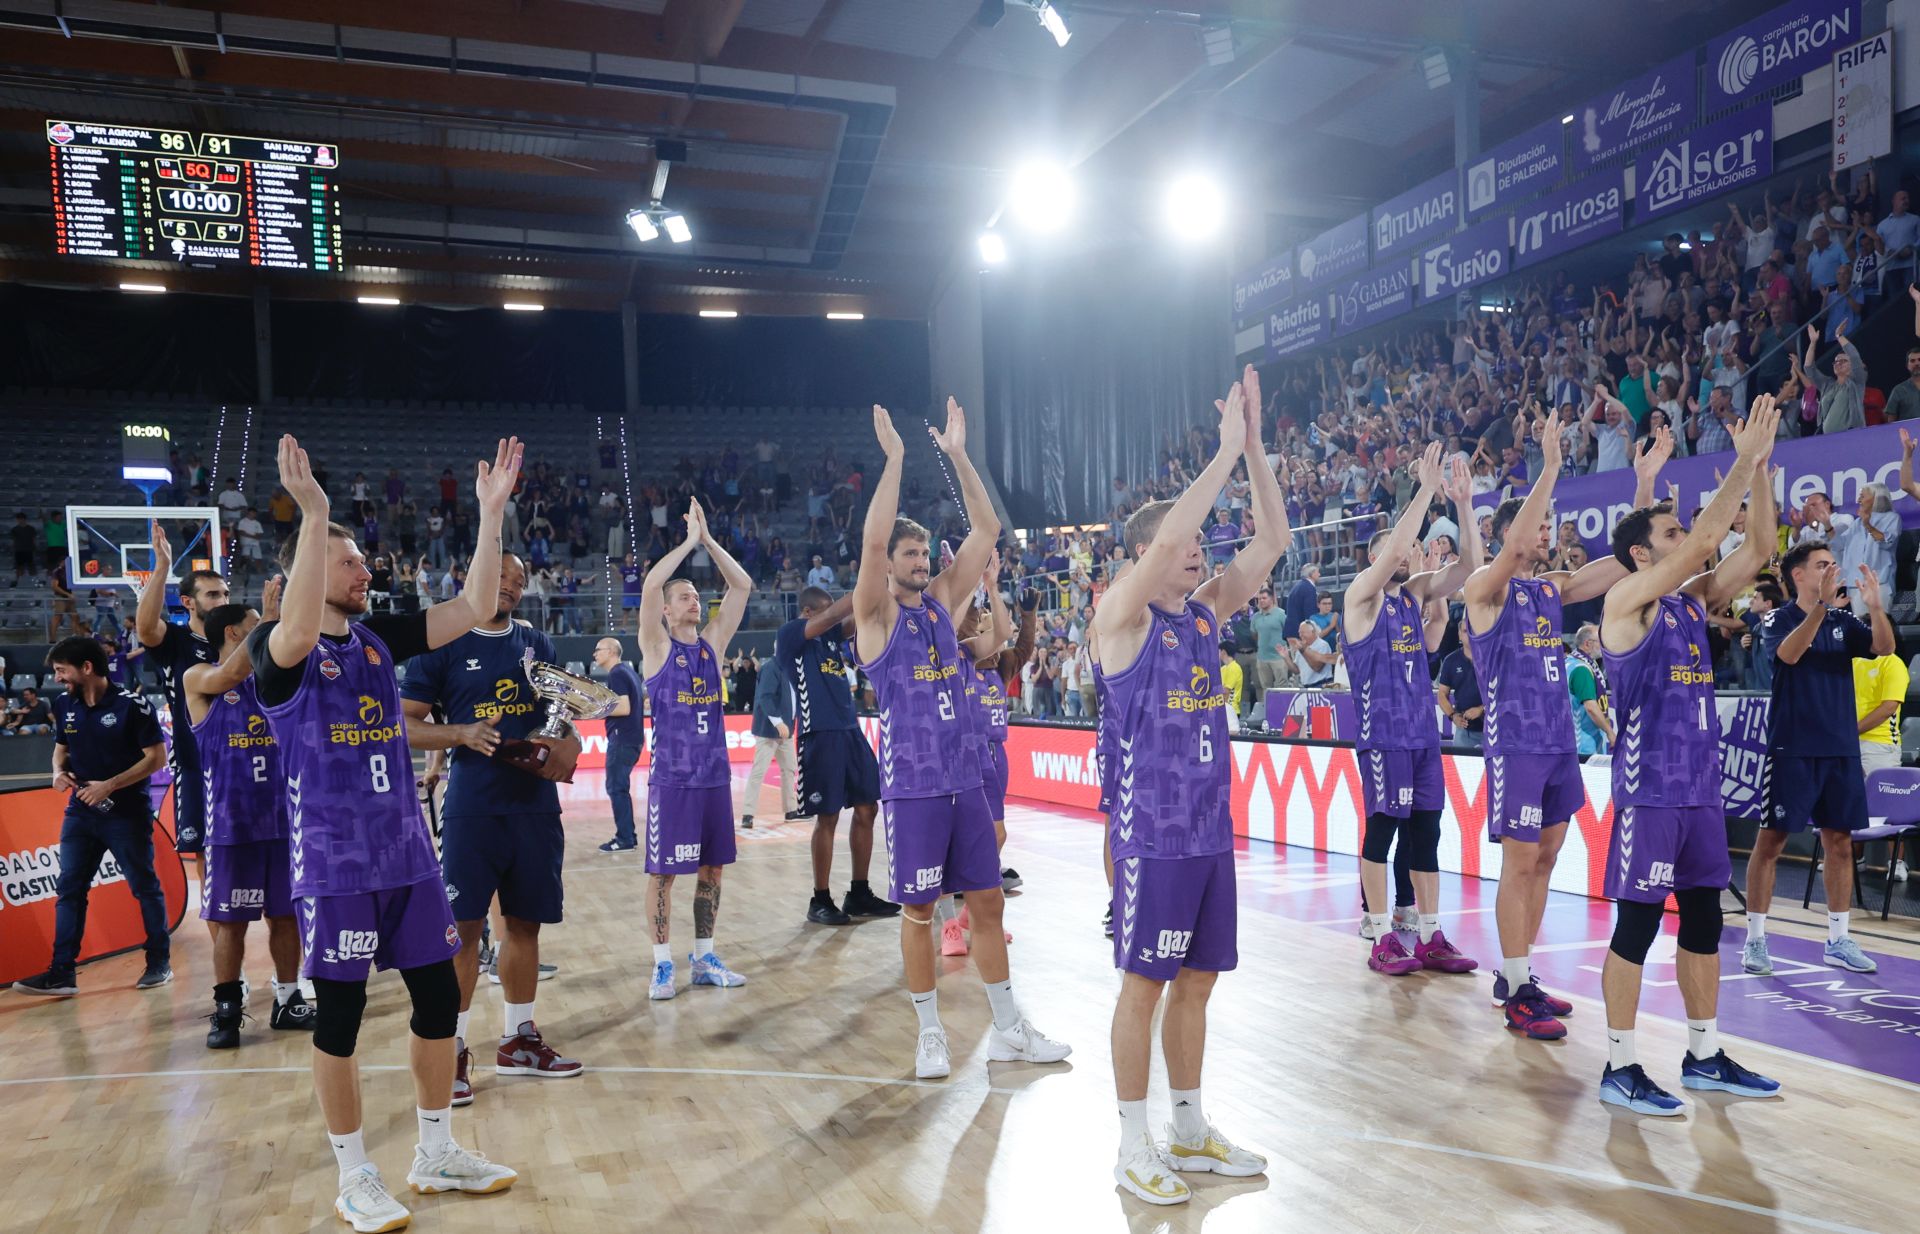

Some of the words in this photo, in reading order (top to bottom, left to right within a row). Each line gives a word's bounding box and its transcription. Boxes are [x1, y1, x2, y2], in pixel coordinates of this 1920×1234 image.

[1838, 37, 1887, 72] RIFA
[75, 124, 106, 135] SÚPER
[108, 128, 152, 139] AGROPAL
[91, 136, 138, 148] PALENCIA
[160, 133, 185, 150] 96
[1591, 147, 1617, 164] SOMOS
[1619, 122, 1673, 151] FABRICANTES
[208, 137, 231, 155] 91
[263, 142, 281, 151] SAN
[283, 144, 312, 154] PABLO
[270, 152, 307, 163] BURGOS
[186, 162, 211, 179] 5Q
[1498, 144, 1546, 174] Diputación
[1498, 177, 1511, 191] DE
[1512, 155, 1558, 185] PALENCIA
[1688, 165, 1757, 199] INSTALACIONES
[169, 190, 232, 212] 10:00
[1551, 188, 1619, 234] nirosa
[176, 222, 187, 236] 5
[1377, 191, 1454, 250] HITUMAR
[217, 226, 227, 240] 5
[188, 245, 240, 254] BALONCESTO
[1247, 266, 1291, 297] INMAPA
[1360, 267, 1408, 304] GABAN
[1270, 299, 1320, 335] Peñafría
[124, 424, 163, 438] 10:00
[1405, 660, 1414, 684] 7
[1543, 655, 1560, 682] 15
[1167, 688, 1191, 697] súper
[329, 721, 359, 730] súper
[697, 711, 709, 735] 5
[991, 708, 1005, 726] 23
[1698, 696, 1708, 731] 1
[1199, 724, 1214, 763] 6
[252, 755, 267, 783] 2
[369, 753, 391, 793] 8
[1878, 784, 1911, 795] Villanova
[674, 843, 702, 863] gaz
[916, 864, 943, 892] gaz
[231, 888, 265, 907] gaza
[338, 929, 379, 961] gaza
[1156, 929, 1194, 960] gaz
